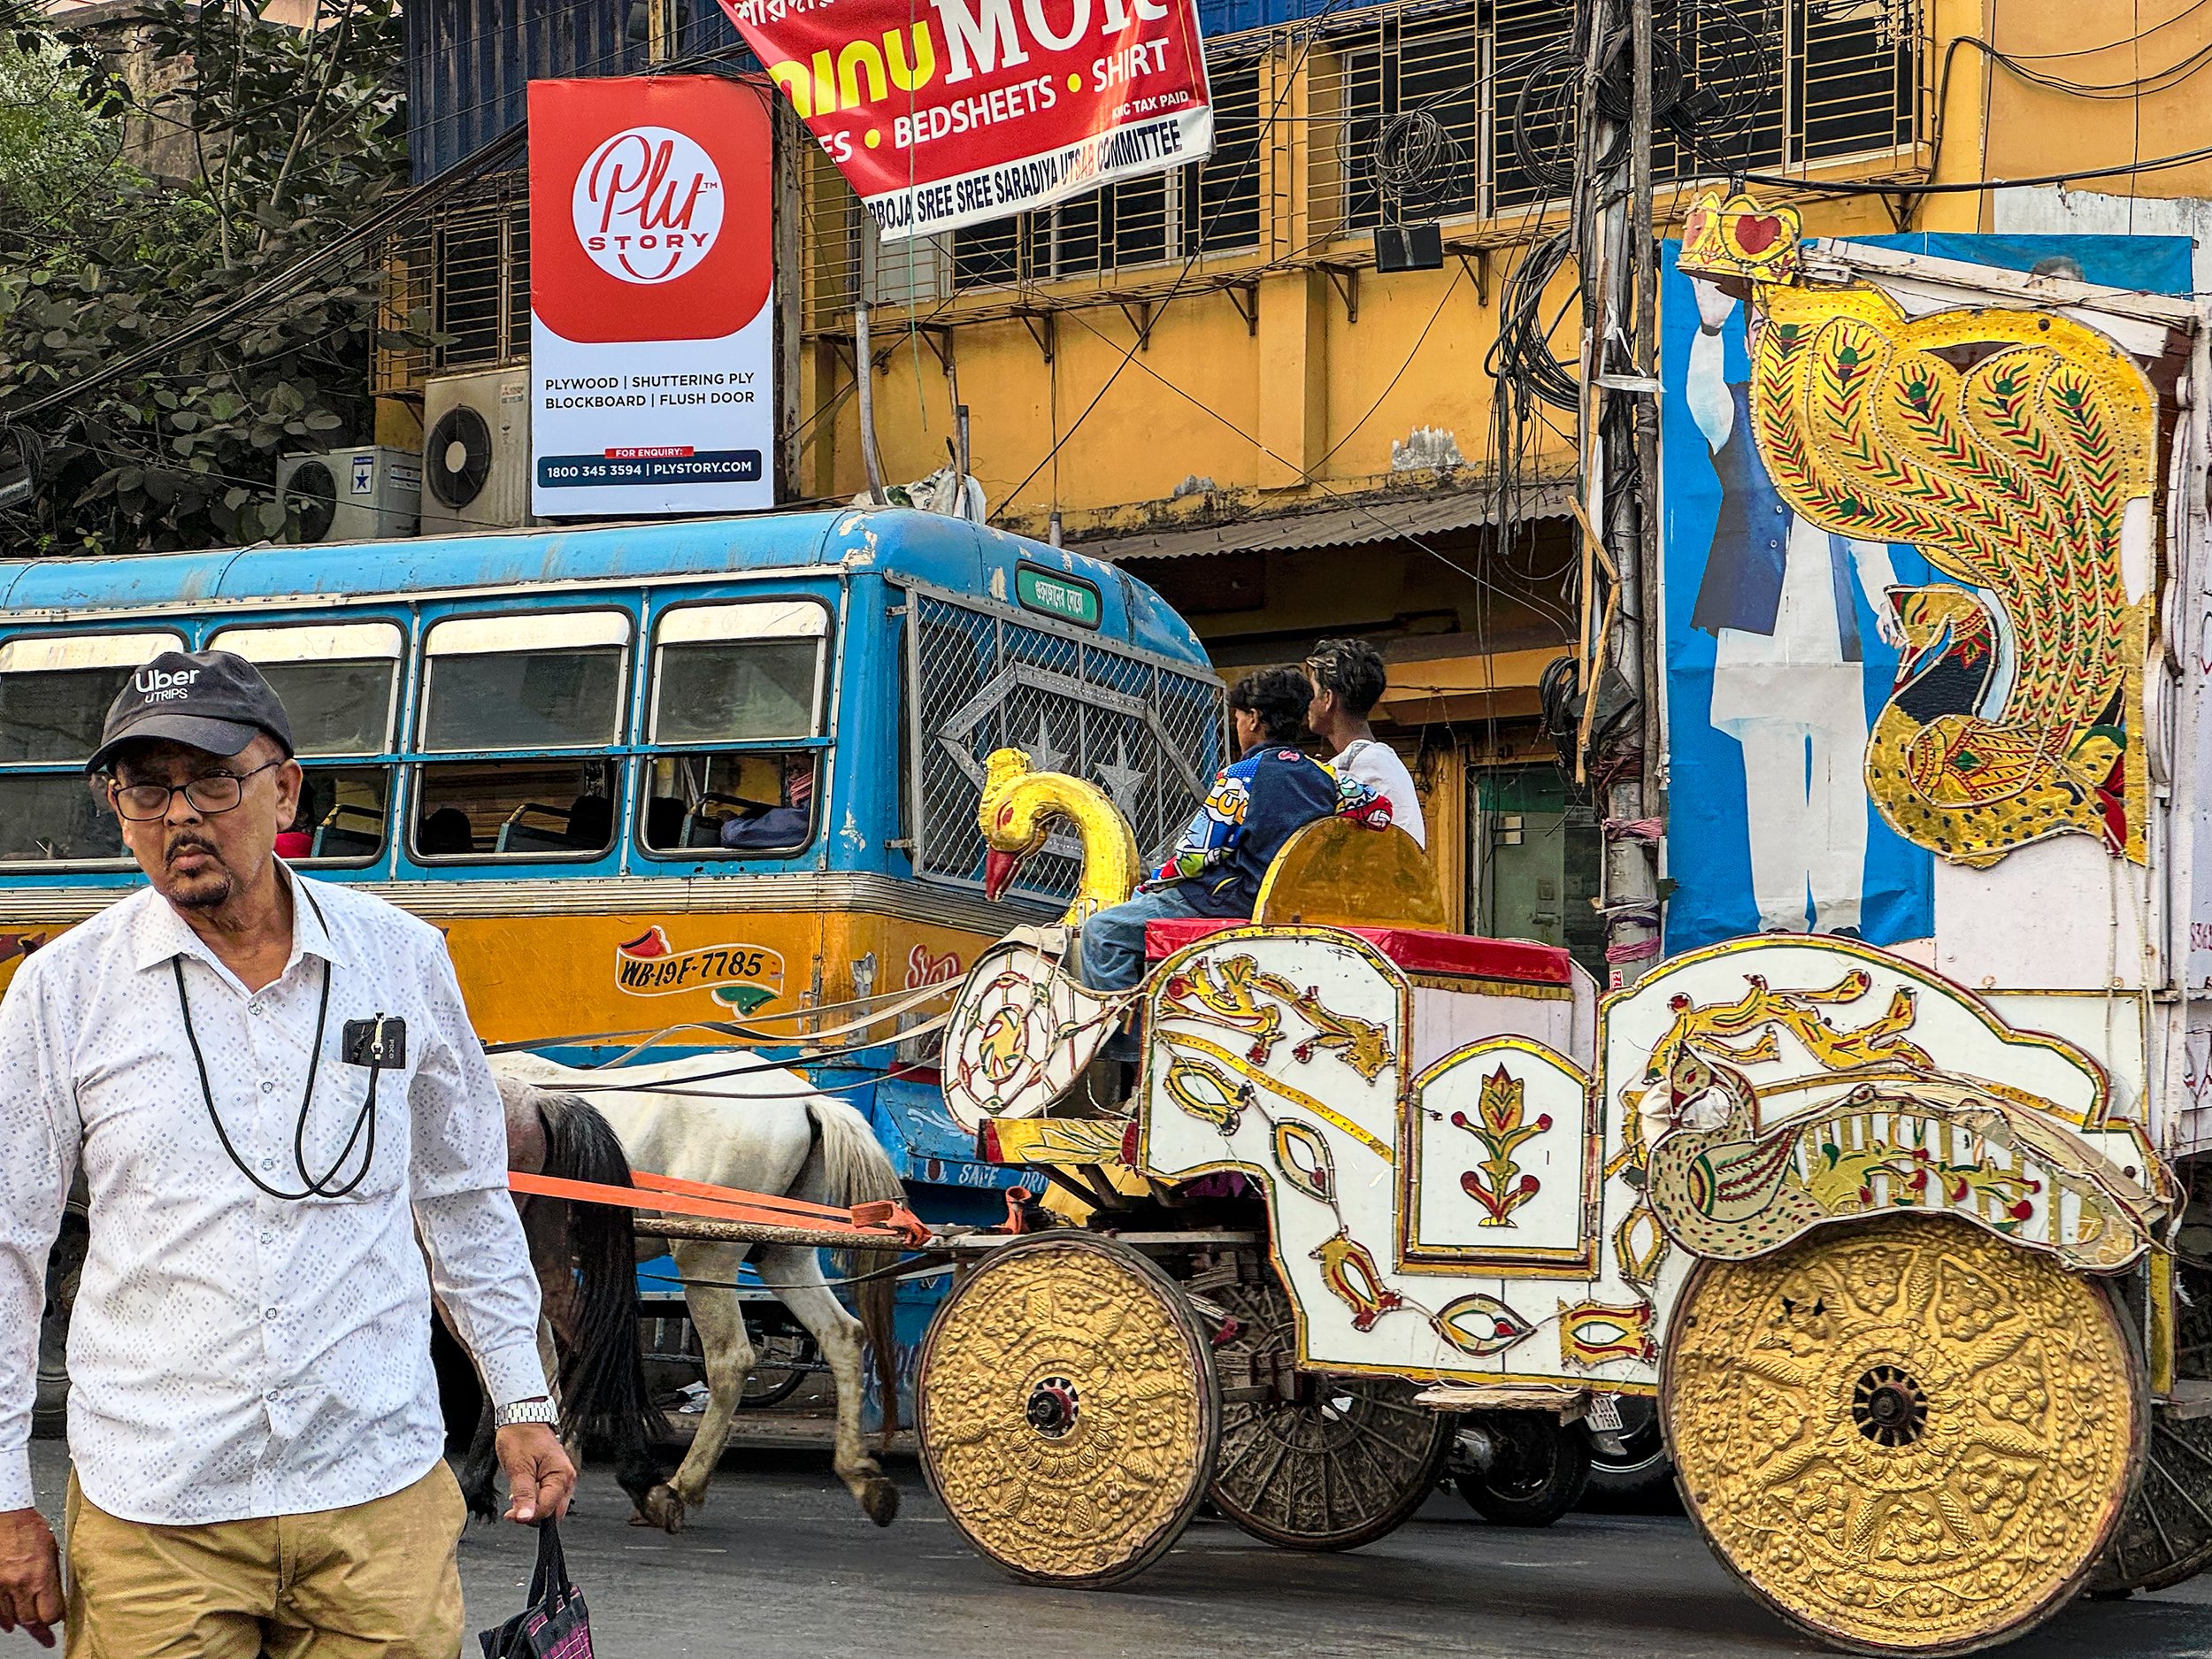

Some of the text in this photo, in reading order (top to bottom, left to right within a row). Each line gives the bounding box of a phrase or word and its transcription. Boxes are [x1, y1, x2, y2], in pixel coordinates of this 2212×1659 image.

[894, 74, 1057, 150] BEDSHEETS
[1092, 38, 1170, 93] SHIRT
[1132, 96, 1158, 113] TAX
[1159, 90, 1189, 107] PAID
[918, 184, 955, 223] SREE
[956, 174, 994, 213] SREE
[994, 156, 1058, 204] SARADIYA
[1059, 142, 1095, 187] UTSAB
[1096, 119, 1183, 173] COMMITTEE
[588, 233, 710, 251] STORY
[545, 373, 755, 391] PLYWOOD SHUTTERING PLY
[545, 392, 755, 410] BLOCKBOARD FLUSH DOOR
[615, 447, 683, 458] FOR ENQUIRY:
[547, 461, 752, 478] 1800 345 3594 PLYSTORY.COM
[135, 669, 200, 693] Uber
[958, 1164, 1000, 1187] SAFE
